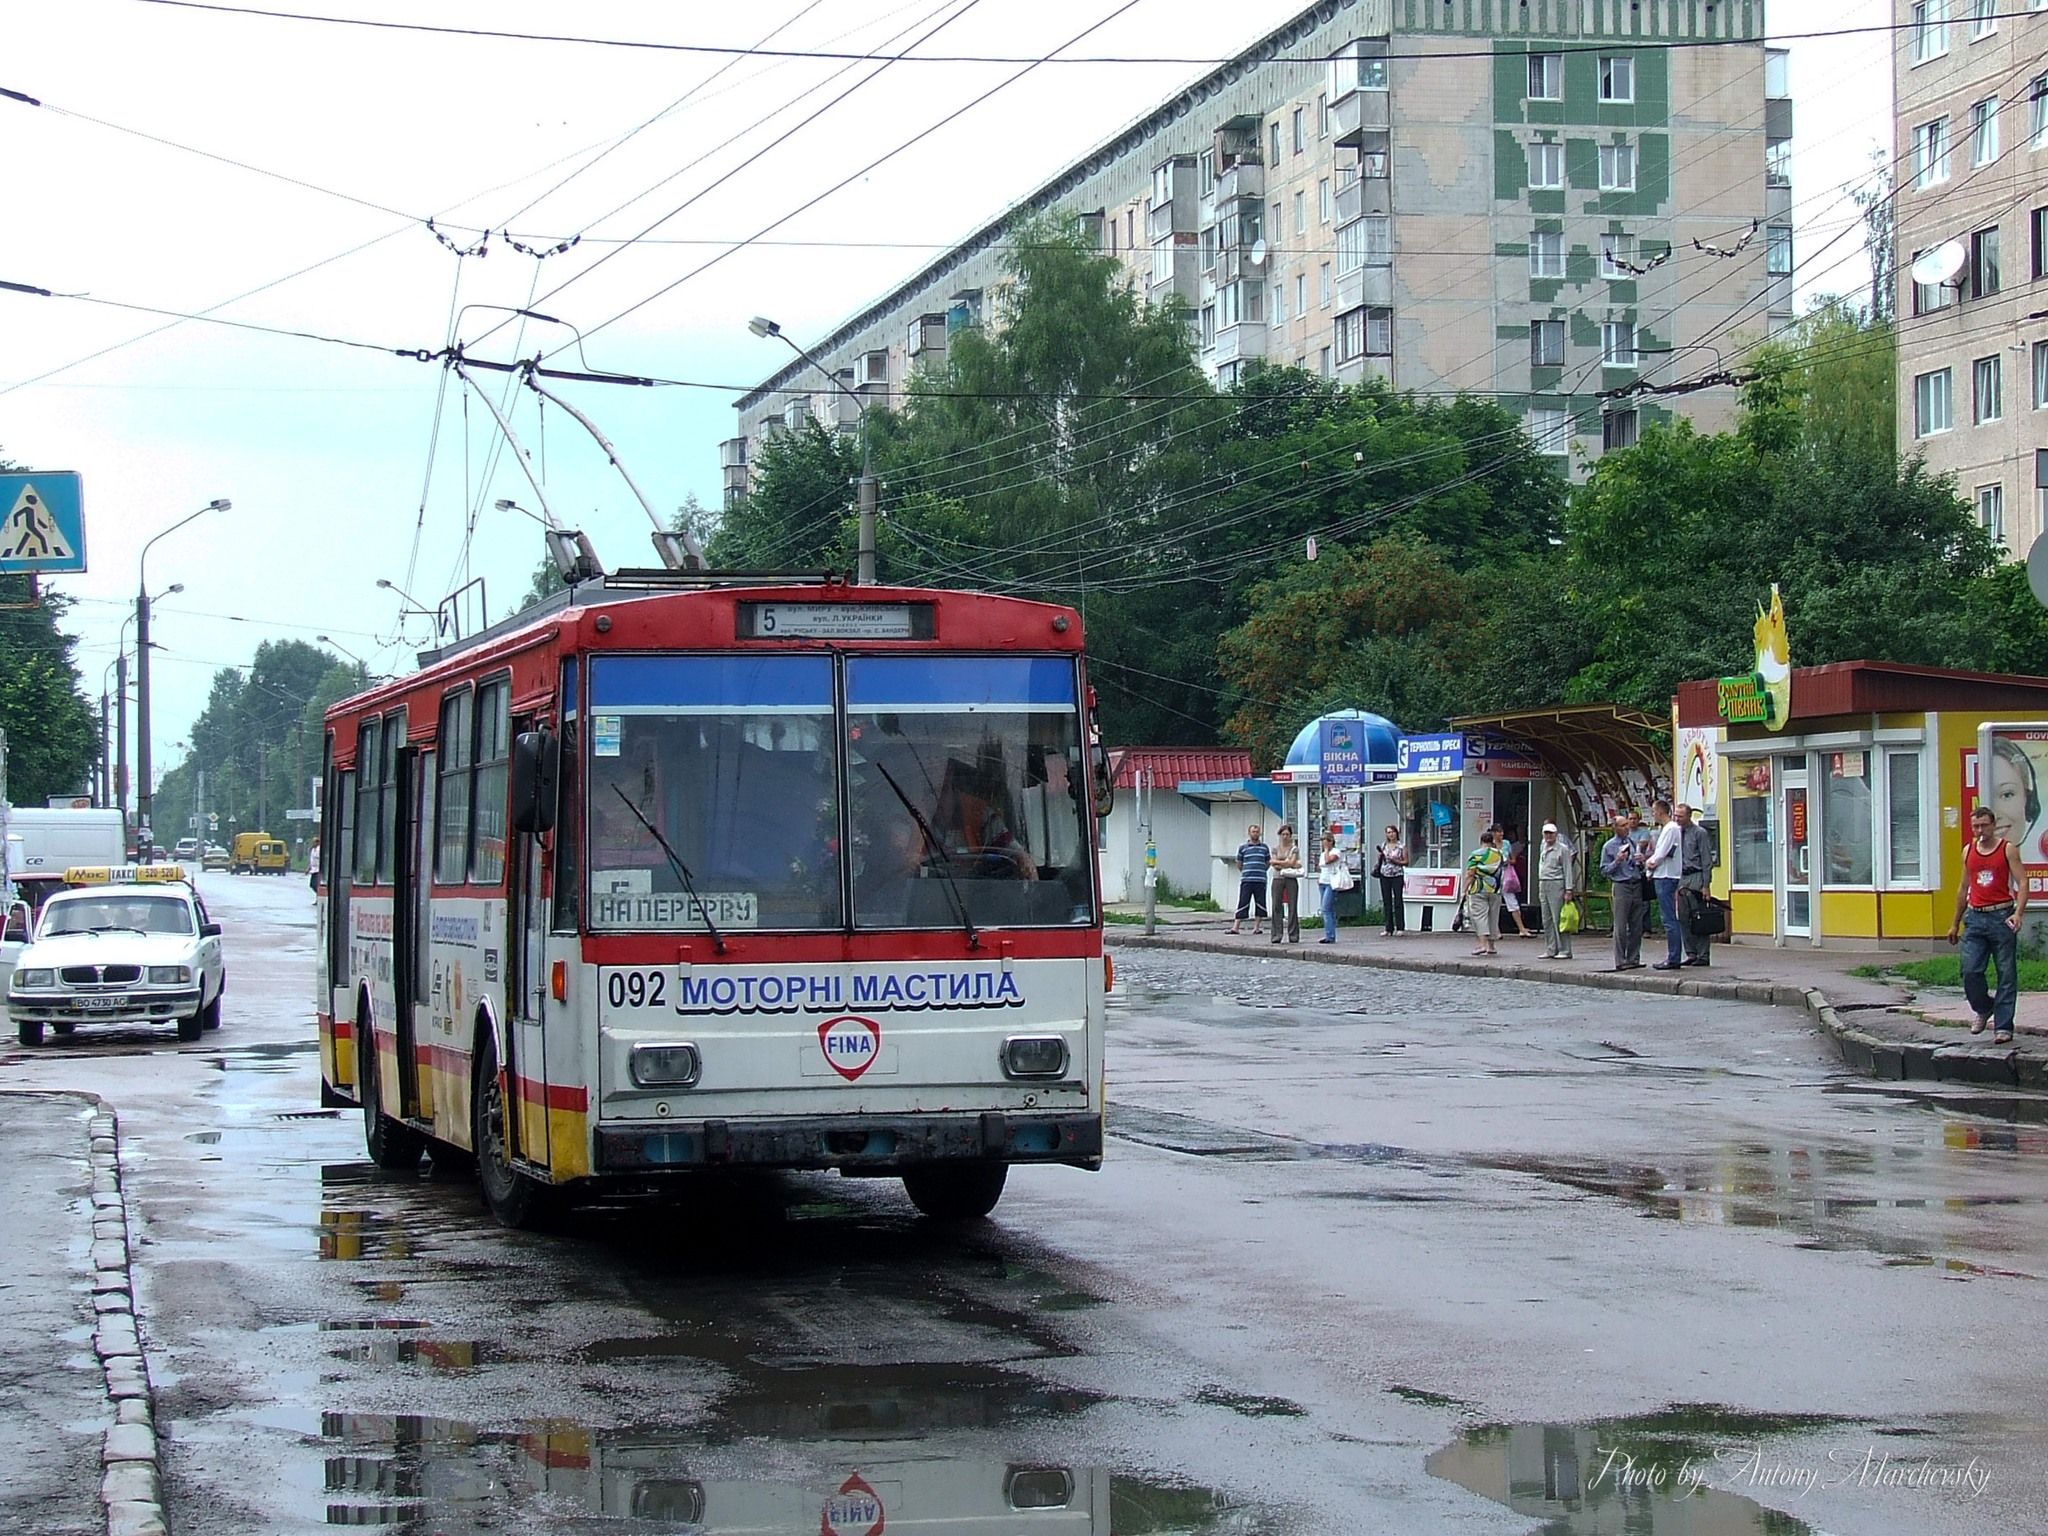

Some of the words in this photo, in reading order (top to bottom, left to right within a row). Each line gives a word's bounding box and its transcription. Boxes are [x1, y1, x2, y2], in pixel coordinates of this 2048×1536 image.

[763, 608, 776, 632] 5
[812, 616, 831, 624] вул.
[1323, 752, 1359, 761] ВІКНА
[601, 900, 631, 922] НА
[637, 899, 751, 922] ПЕРЕРВУ
[608, 971, 666, 1008] 092
[681, 974, 841, 1006] МОТОРНІ
[853, 971, 1020, 1002] МАСТИЛА
[828, 1036, 872, 1054] FINA
